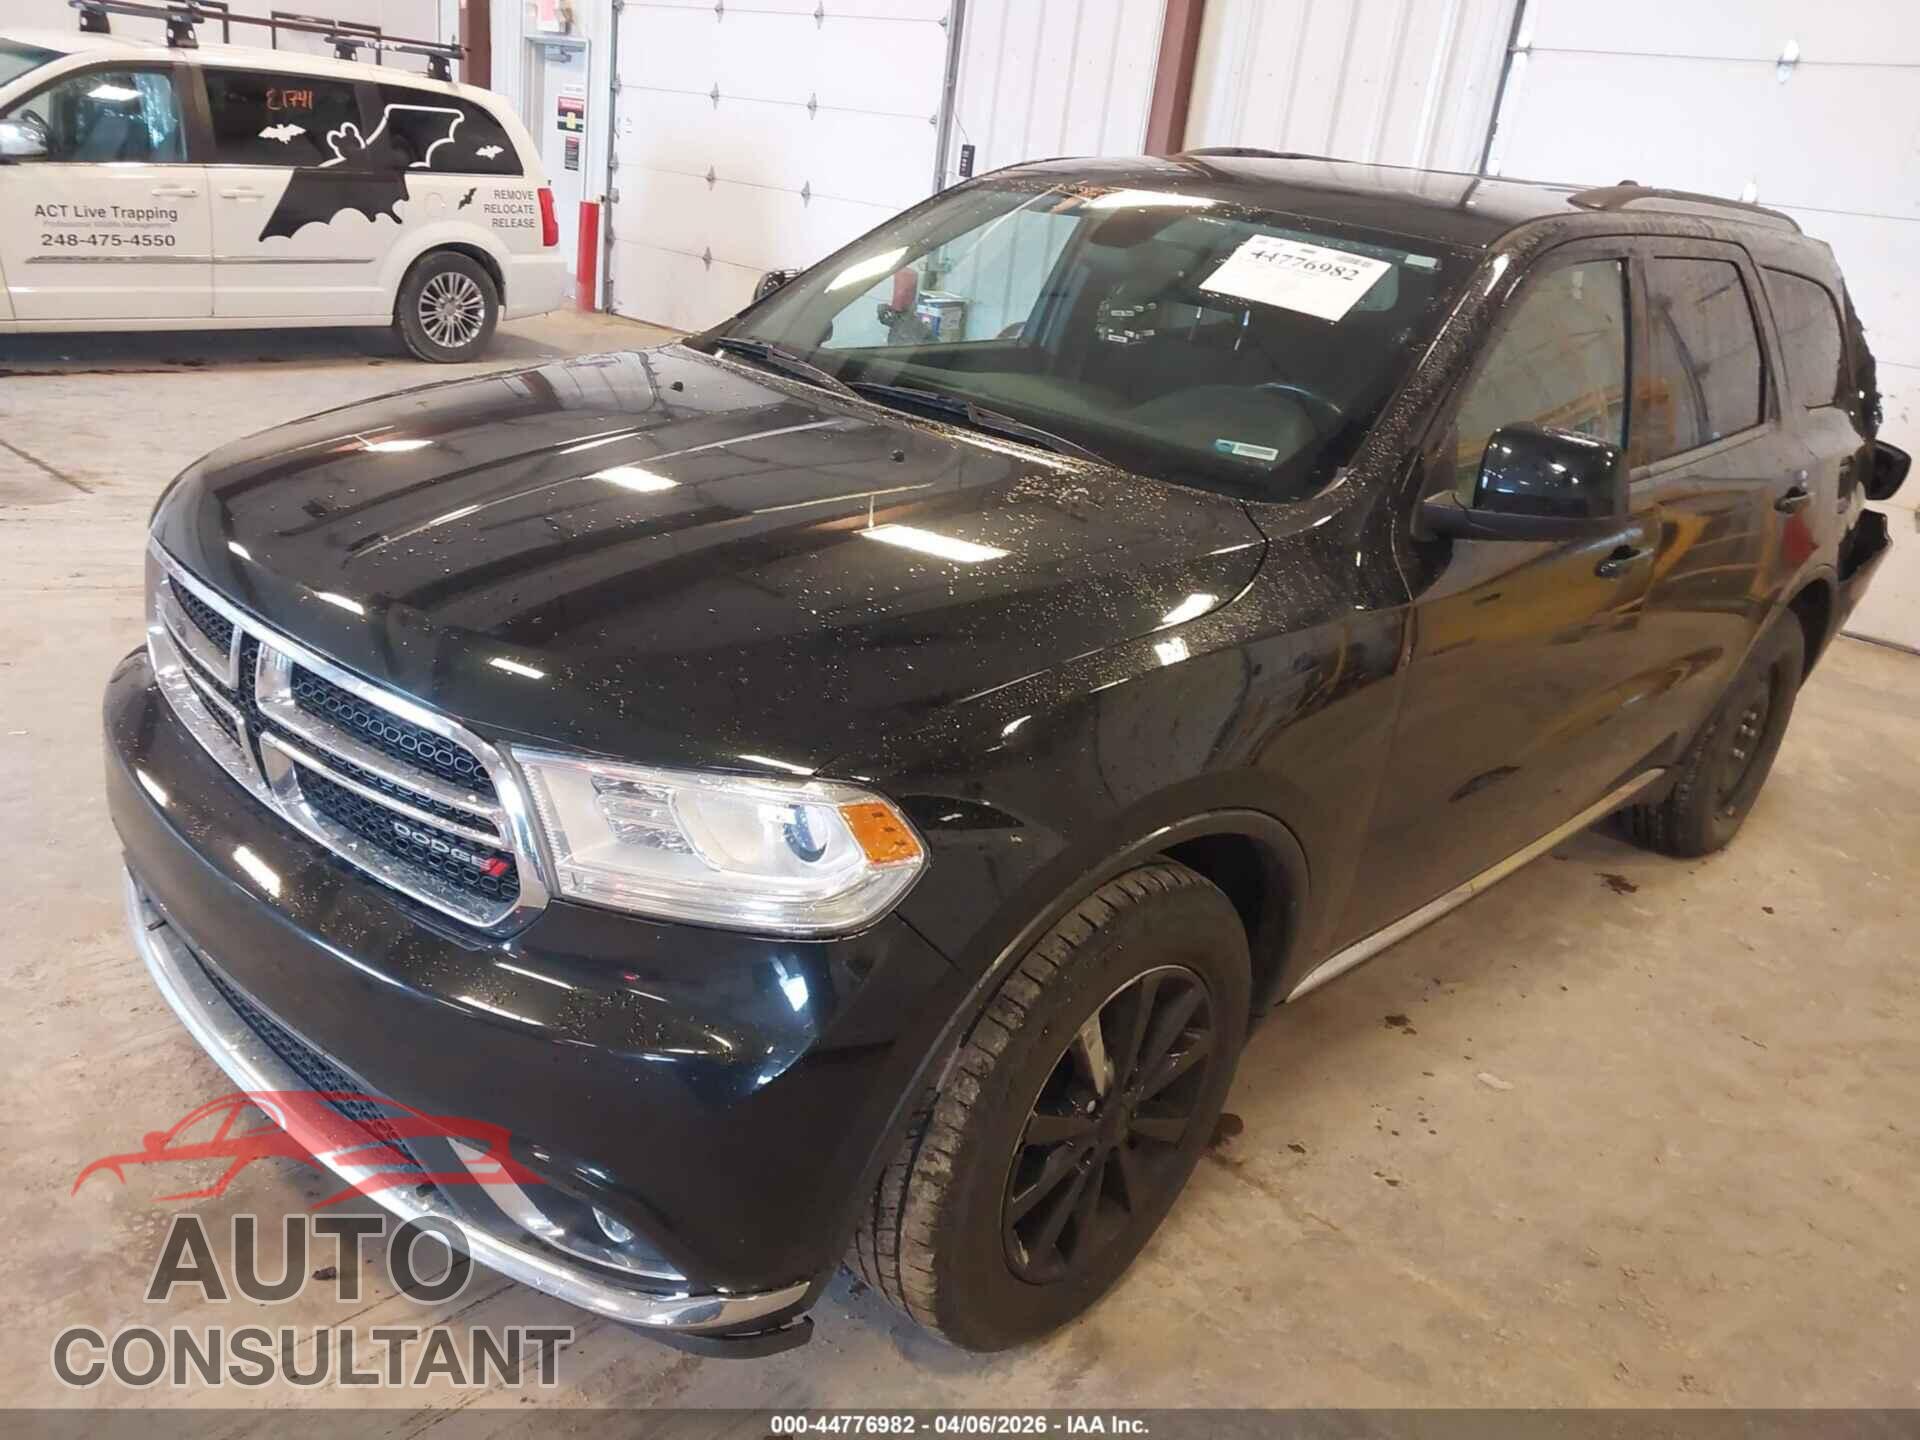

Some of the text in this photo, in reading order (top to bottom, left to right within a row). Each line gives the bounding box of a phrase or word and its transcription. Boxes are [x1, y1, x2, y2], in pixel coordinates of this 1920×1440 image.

[494, 190, 534, 200] REMOVE
[34, 204, 178, 222] ACT Live Trapping
[483, 203, 534, 214] RELOCATE
[491, 218, 535, 228] RELEASE
[40, 233, 176, 247] 248-475-4550
[1250, 250, 1359, 281] 44776982
[393, 822, 490, 873] DODGE
